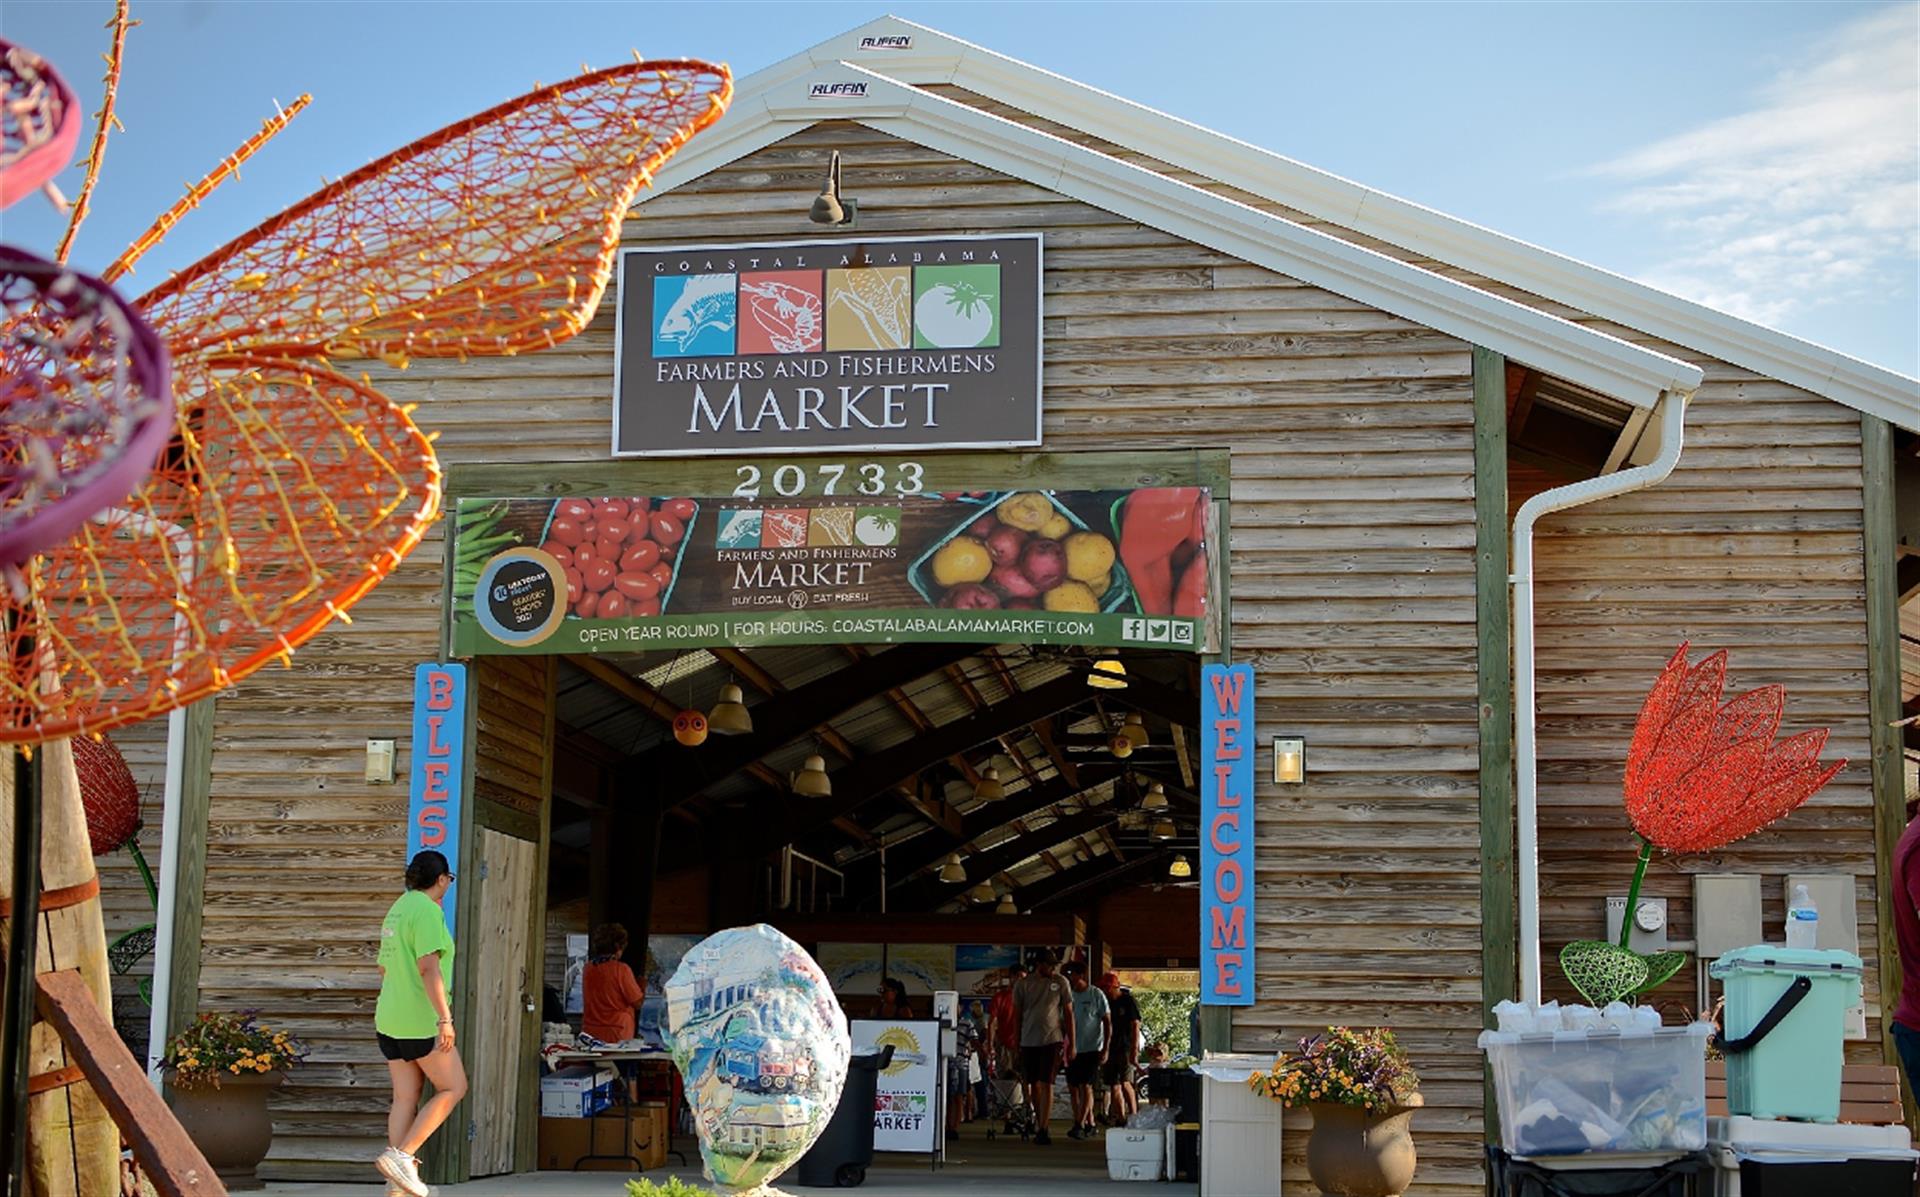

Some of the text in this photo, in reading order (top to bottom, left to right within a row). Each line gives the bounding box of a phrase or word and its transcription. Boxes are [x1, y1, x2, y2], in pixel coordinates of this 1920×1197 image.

[861, 36, 911, 47] RUFFIN
[812, 82, 868, 94] RUFFIN
[655, 250, 999, 272] COASTAL ALABAMA
[656, 354, 996, 382] FARMERS AND FISHERMENS
[686, 382, 950, 433] MARKET
[732, 462, 925, 497] 20733
[717, 548, 897, 562] FARMERS AND FISHERMENS
[732, 561, 872, 590] MARKET
[732, 592, 869, 606] BUY LOCAL EAT FRESH
[579, 629, 619, 643] OPEN
[622, 626, 662, 641] YEAR
[666, 623, 720, 638] ROUND
[734, 622, 765, 635] FOR
[770, 620, 828, 635] HOURS:
[1209, 672, 1247, 997] WELCOME
[873, 1116, 922, 1130] ARKET
